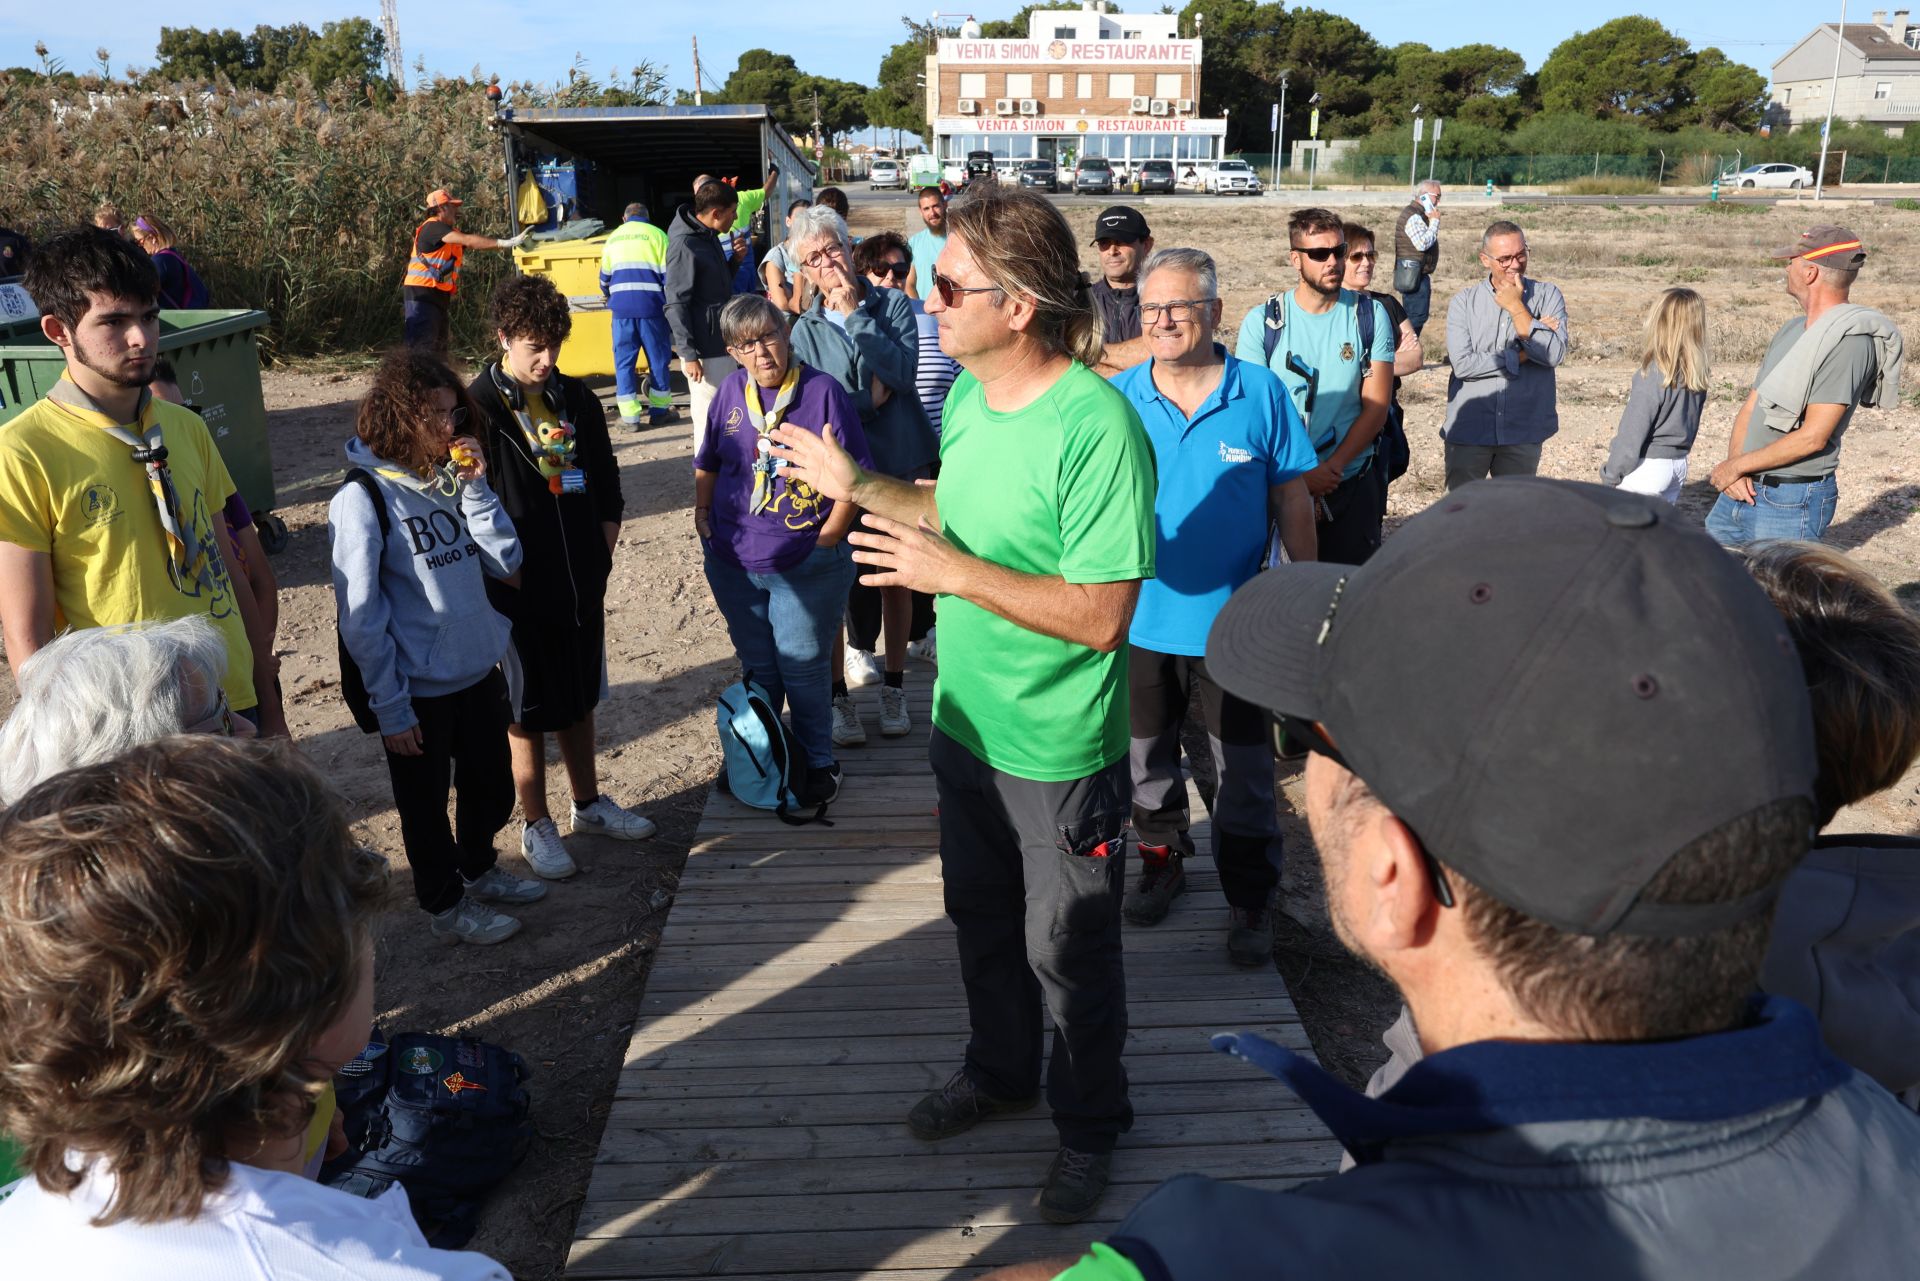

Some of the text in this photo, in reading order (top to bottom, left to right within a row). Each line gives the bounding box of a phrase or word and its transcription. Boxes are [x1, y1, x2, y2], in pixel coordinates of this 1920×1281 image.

[956, 43, 996, 59] VENTA
[1071, 44, 1193, 60] RESTAURANTE
[976, 119, 1018, 131] VENTA
[1097, 120, 1186, 131] RESTAURANTE
[425, 549, 462, 570] HUGO
